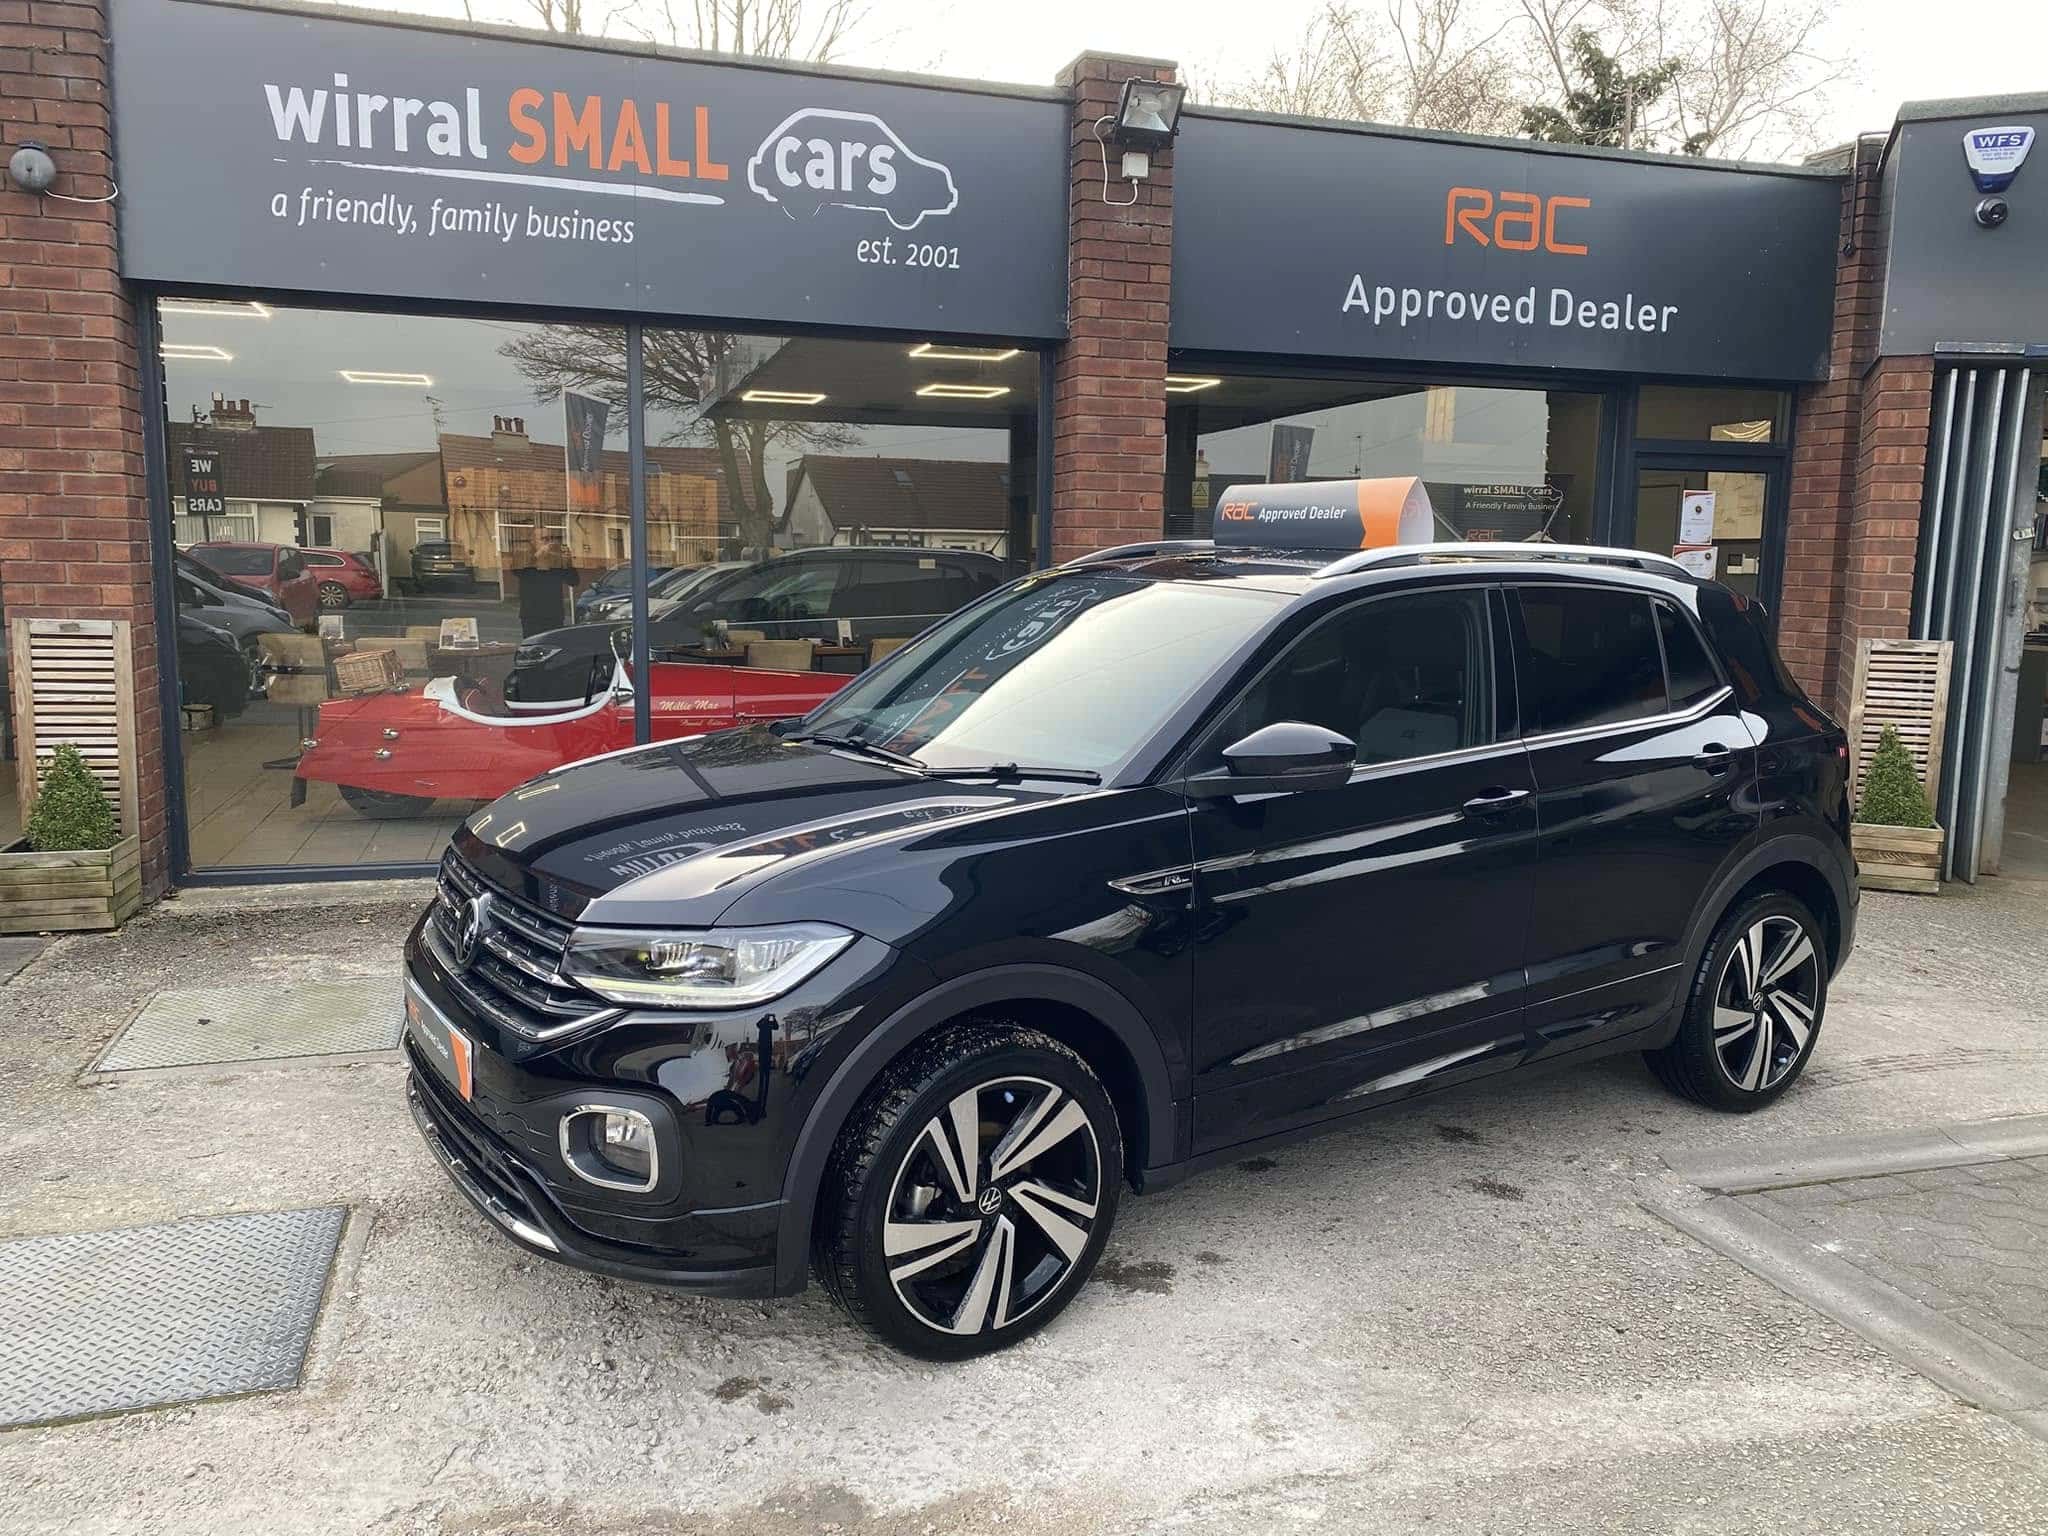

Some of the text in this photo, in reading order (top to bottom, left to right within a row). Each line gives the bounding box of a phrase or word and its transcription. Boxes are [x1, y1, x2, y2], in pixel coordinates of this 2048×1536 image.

[263, 72, 897, 195] wirral SMALL cars
[1978, 134, 2021, 147] WFS
[271, 187, 635, 244] a friendly, family business
[857, 236, 961, 269] est. 2001
[1342, 273, 1680, 333] Approved Dealer
[1463, 485, 1552, 496] wirral SMALL cars
[1258, 508, 1307, 523] Approved
[1309, 505, 1347, 520] Dealer
[1473, 501, 1502, 512] Friendly
[1503, 503, 1526, 512] Family
